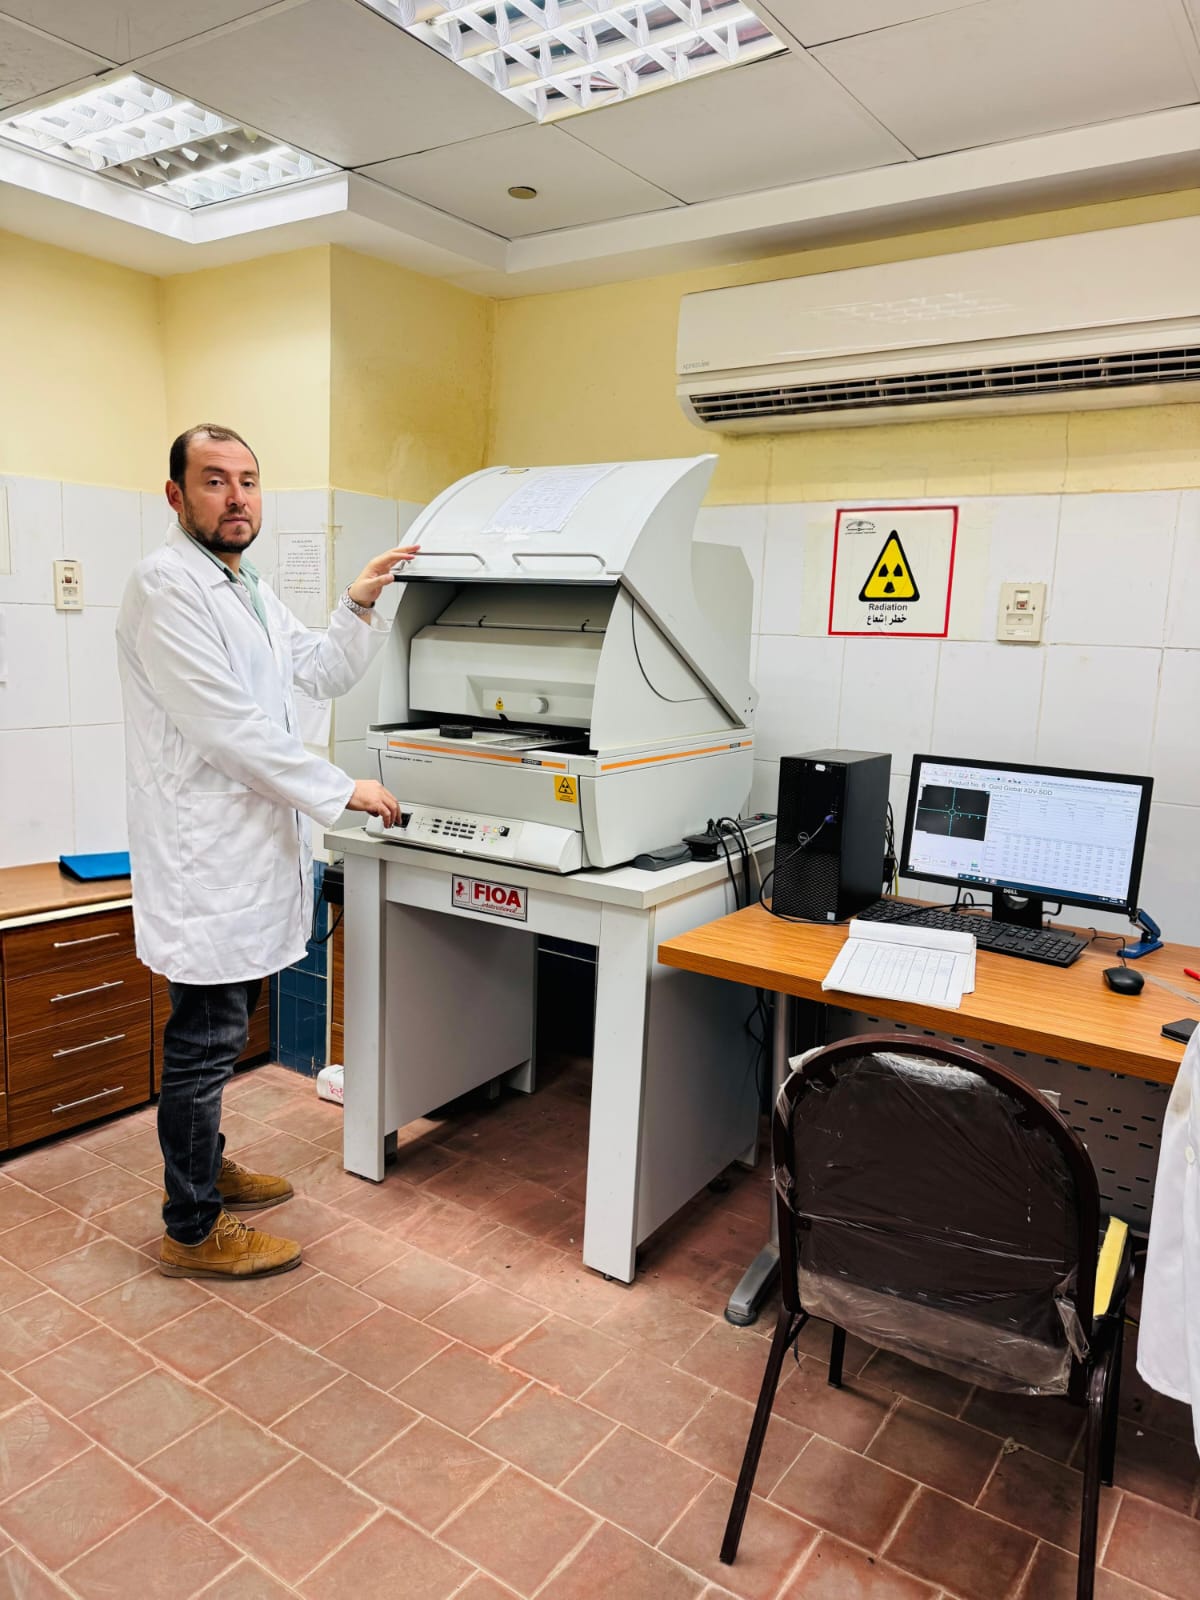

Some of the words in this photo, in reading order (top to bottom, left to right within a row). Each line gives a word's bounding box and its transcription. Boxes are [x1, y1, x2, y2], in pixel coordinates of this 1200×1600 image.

[868, 603, 908, 611] Radiation
[888, 613, 907, 625] خطر
[474, 883, 521, 908] FIOA
